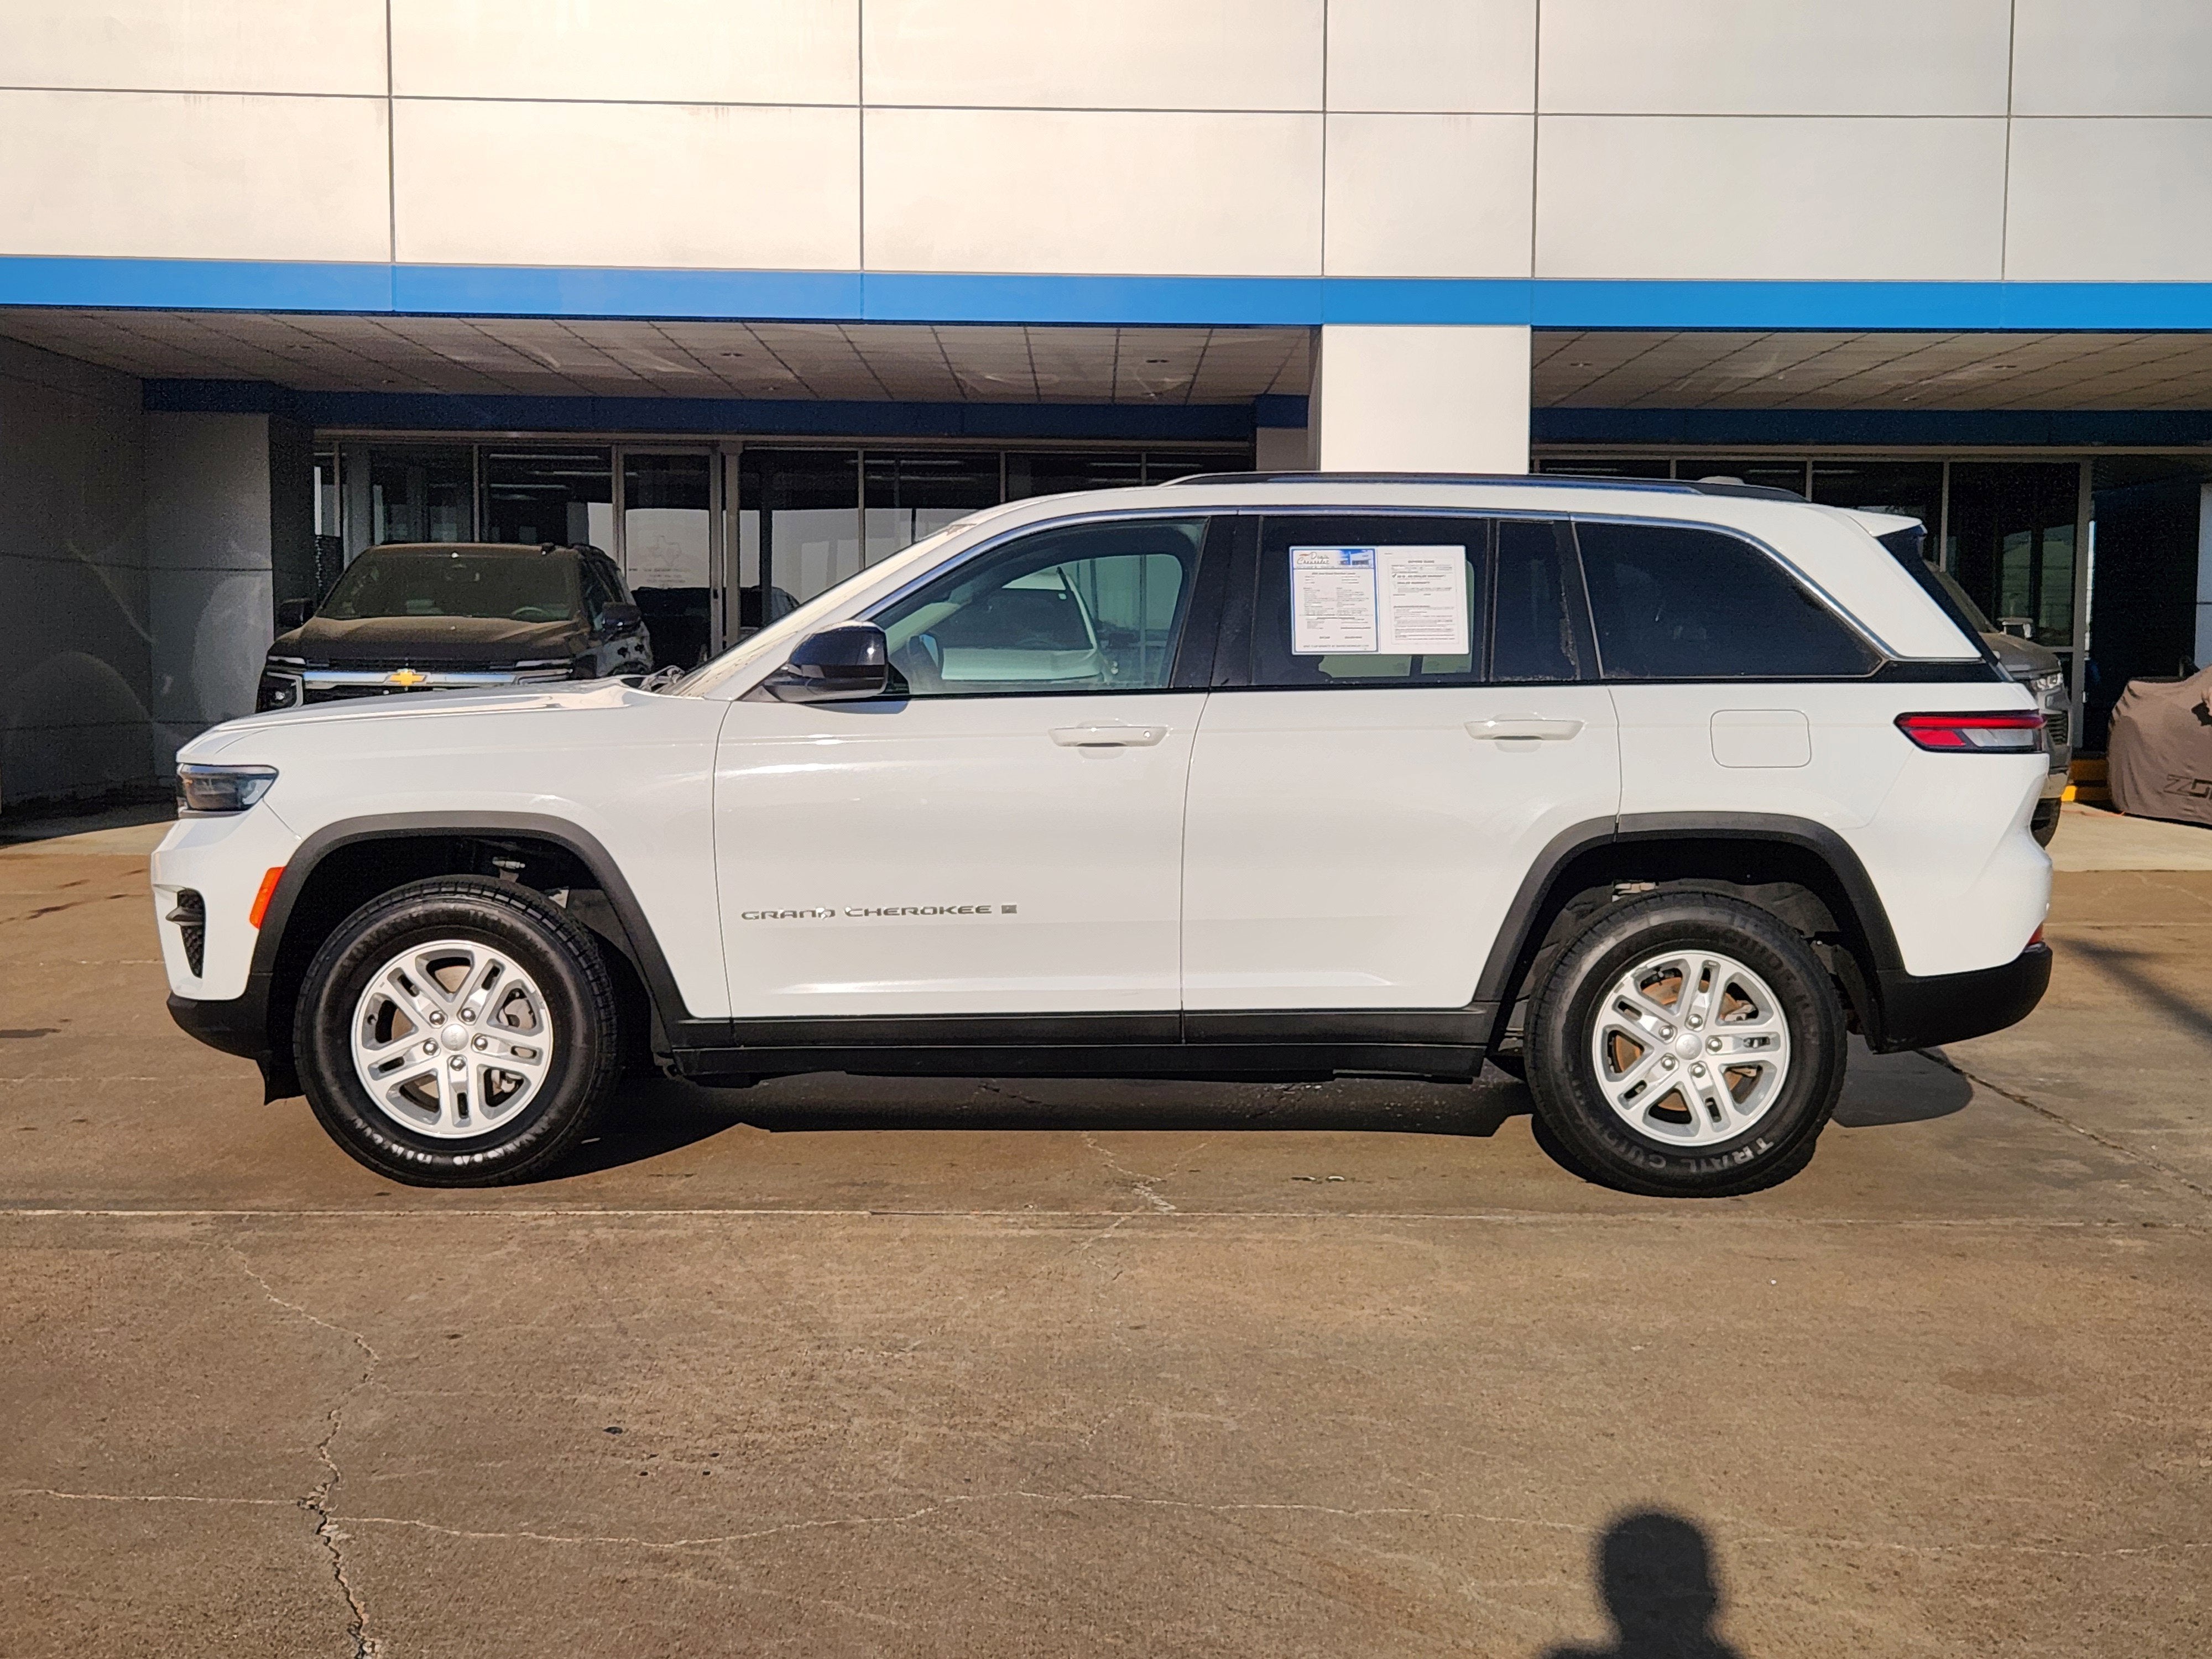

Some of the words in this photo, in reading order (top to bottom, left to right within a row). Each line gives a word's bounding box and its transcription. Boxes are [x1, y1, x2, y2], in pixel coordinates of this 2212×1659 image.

[742, 907, 836, 920] GRAND
[844, 905, 992, 917] CHEROKEE
[1681, 1138, 1774, 1173] TRAIL
